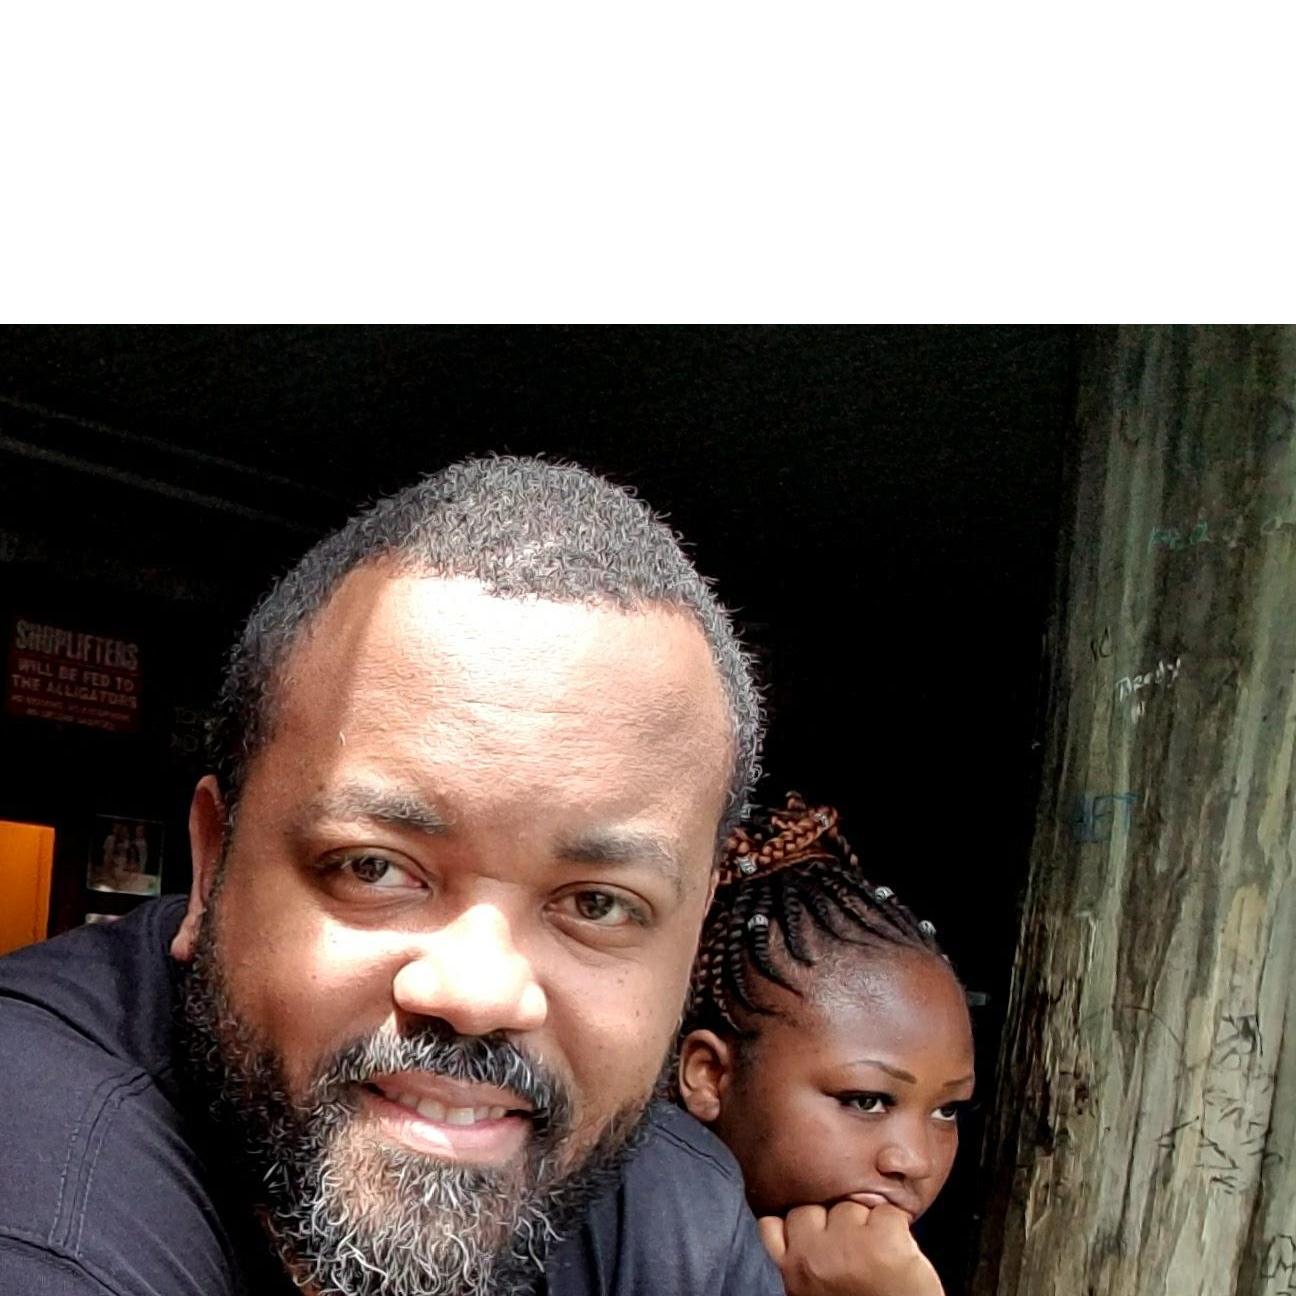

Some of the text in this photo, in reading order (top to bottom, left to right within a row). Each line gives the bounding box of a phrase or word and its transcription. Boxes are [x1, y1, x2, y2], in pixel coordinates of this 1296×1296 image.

[15, 620, 139, 671] SHOPLIFTERS
[11, 674, 41, 691] THE
[18, 658, 54, 677] WILL
[83, 671, 111, 688] FED
[115, 677, 135, 693] TO
